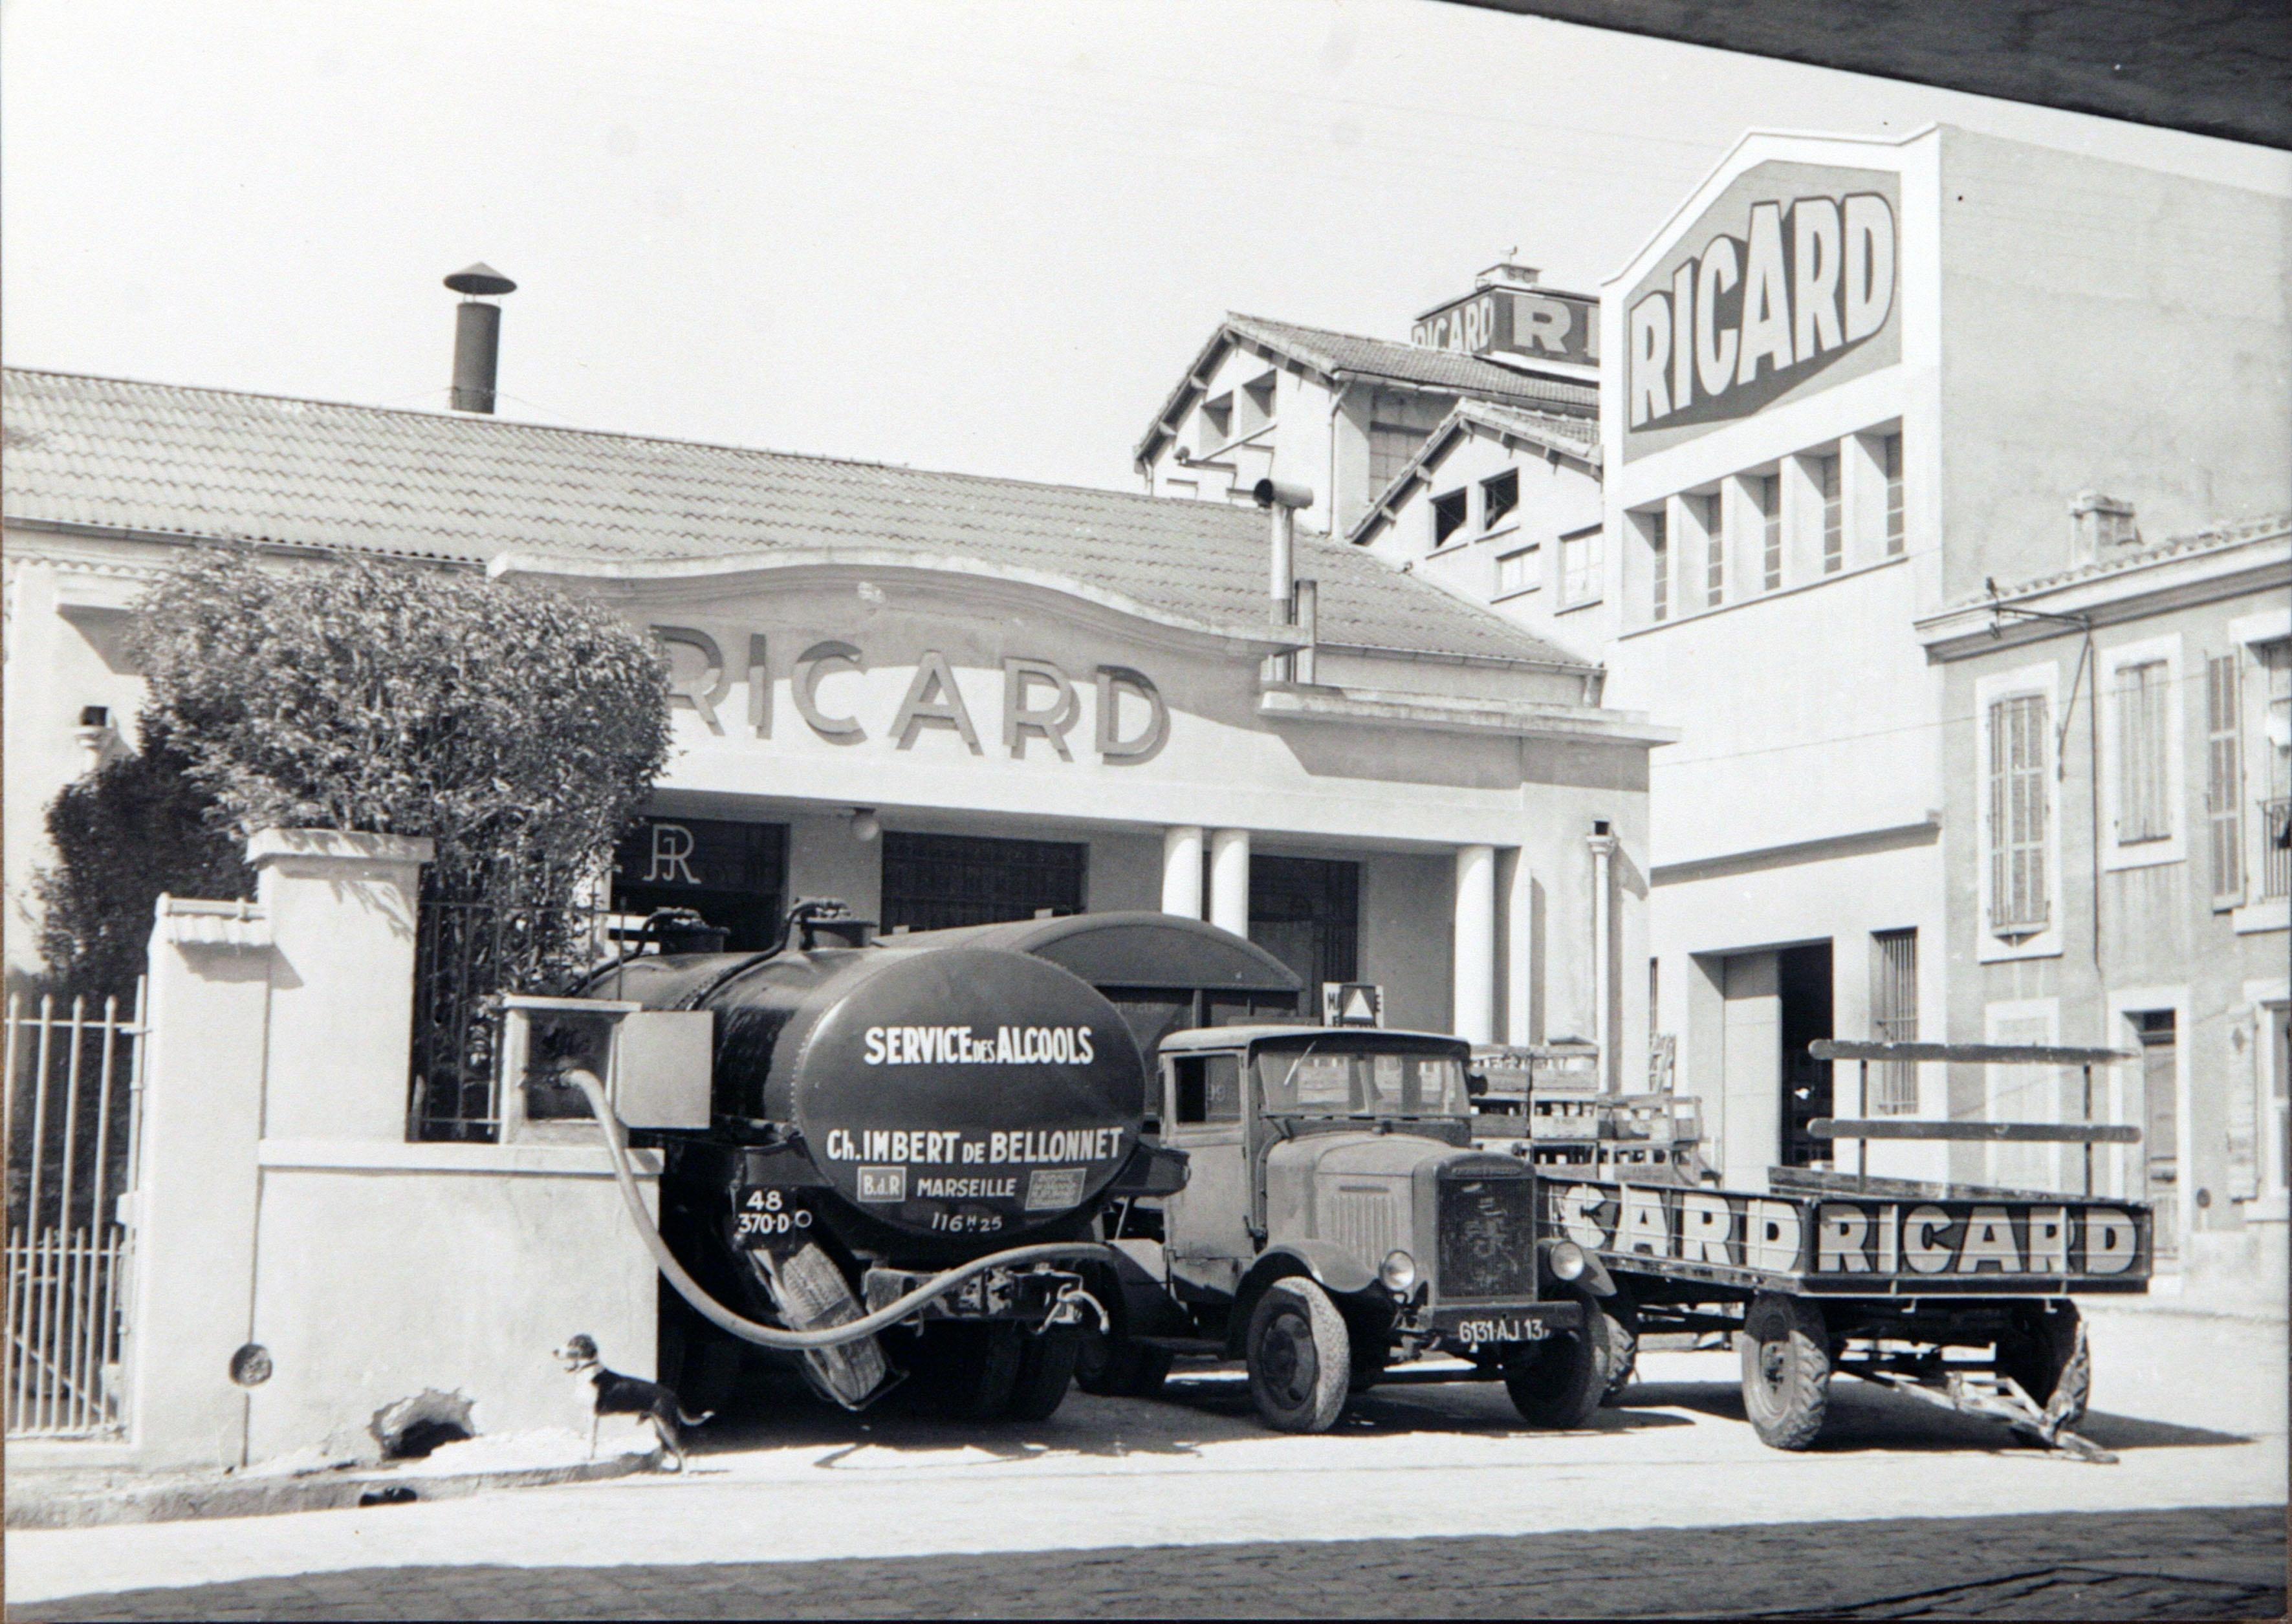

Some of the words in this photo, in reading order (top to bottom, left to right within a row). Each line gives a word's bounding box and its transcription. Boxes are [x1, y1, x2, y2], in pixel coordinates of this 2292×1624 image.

[1630, 193, 1895, 430] RICARD
[649, 624, 1171, 765] RICARD
[864, 1026, 972, 1065] SERVICE
[972, 1039, 994, 1063] DES
[996, 1025, 1094, 1064] ALCOOLS
[962, 1142, 986, 1164] DE
[989, 1127, 1124, 1163] BELLONNET
[747, 1190, 783, 1211] 48
[917, 1178, 1018, 1197] MARSEILLE
[1556, 1184, 1802, 1272] CARD
[1818, 1204, 2137, 1275] RICARD
